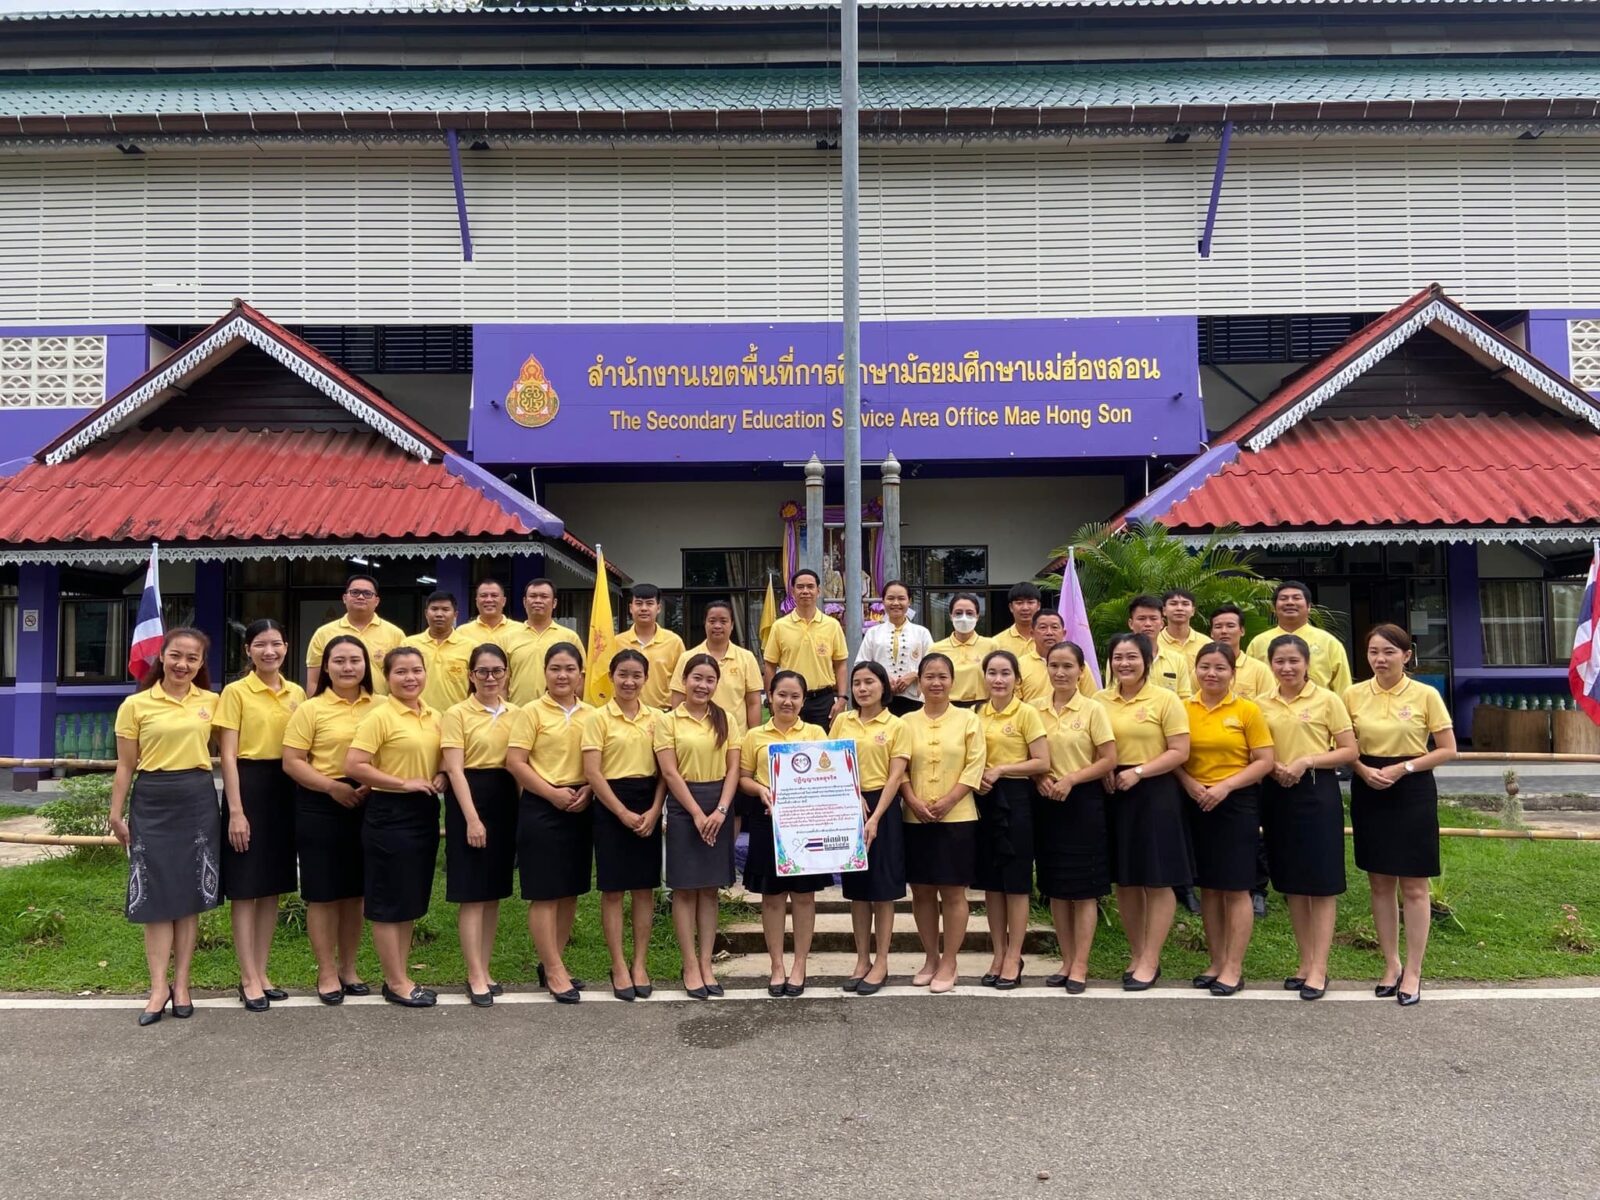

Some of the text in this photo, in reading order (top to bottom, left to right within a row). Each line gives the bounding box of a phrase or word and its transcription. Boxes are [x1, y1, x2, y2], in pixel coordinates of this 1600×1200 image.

[610, 403, 1132, 433] The Secondary Education Svice Area Office Mae Hong Son
